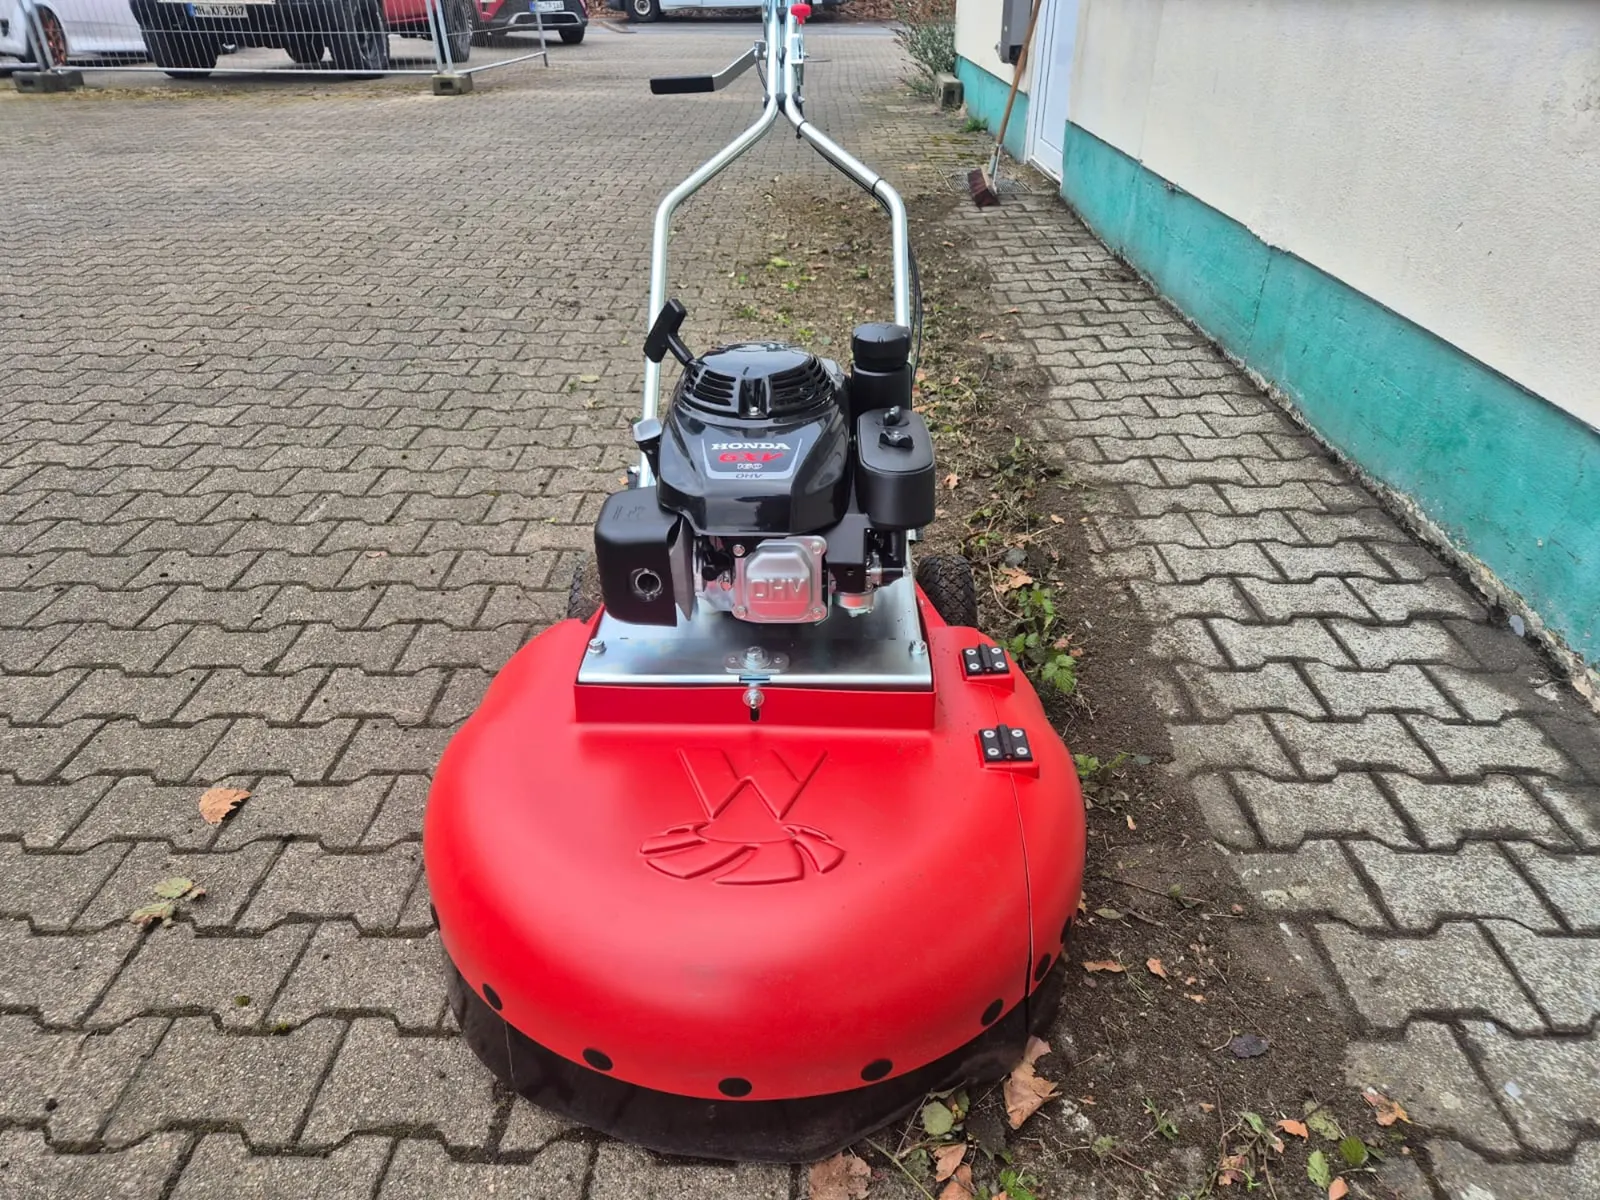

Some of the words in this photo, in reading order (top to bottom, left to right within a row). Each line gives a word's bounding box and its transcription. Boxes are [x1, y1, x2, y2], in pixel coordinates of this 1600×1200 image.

[711, 442, 791, 450] HONDA
[718, 452, 784, 462] GXV
[751, 578, 805, 600] OHV
